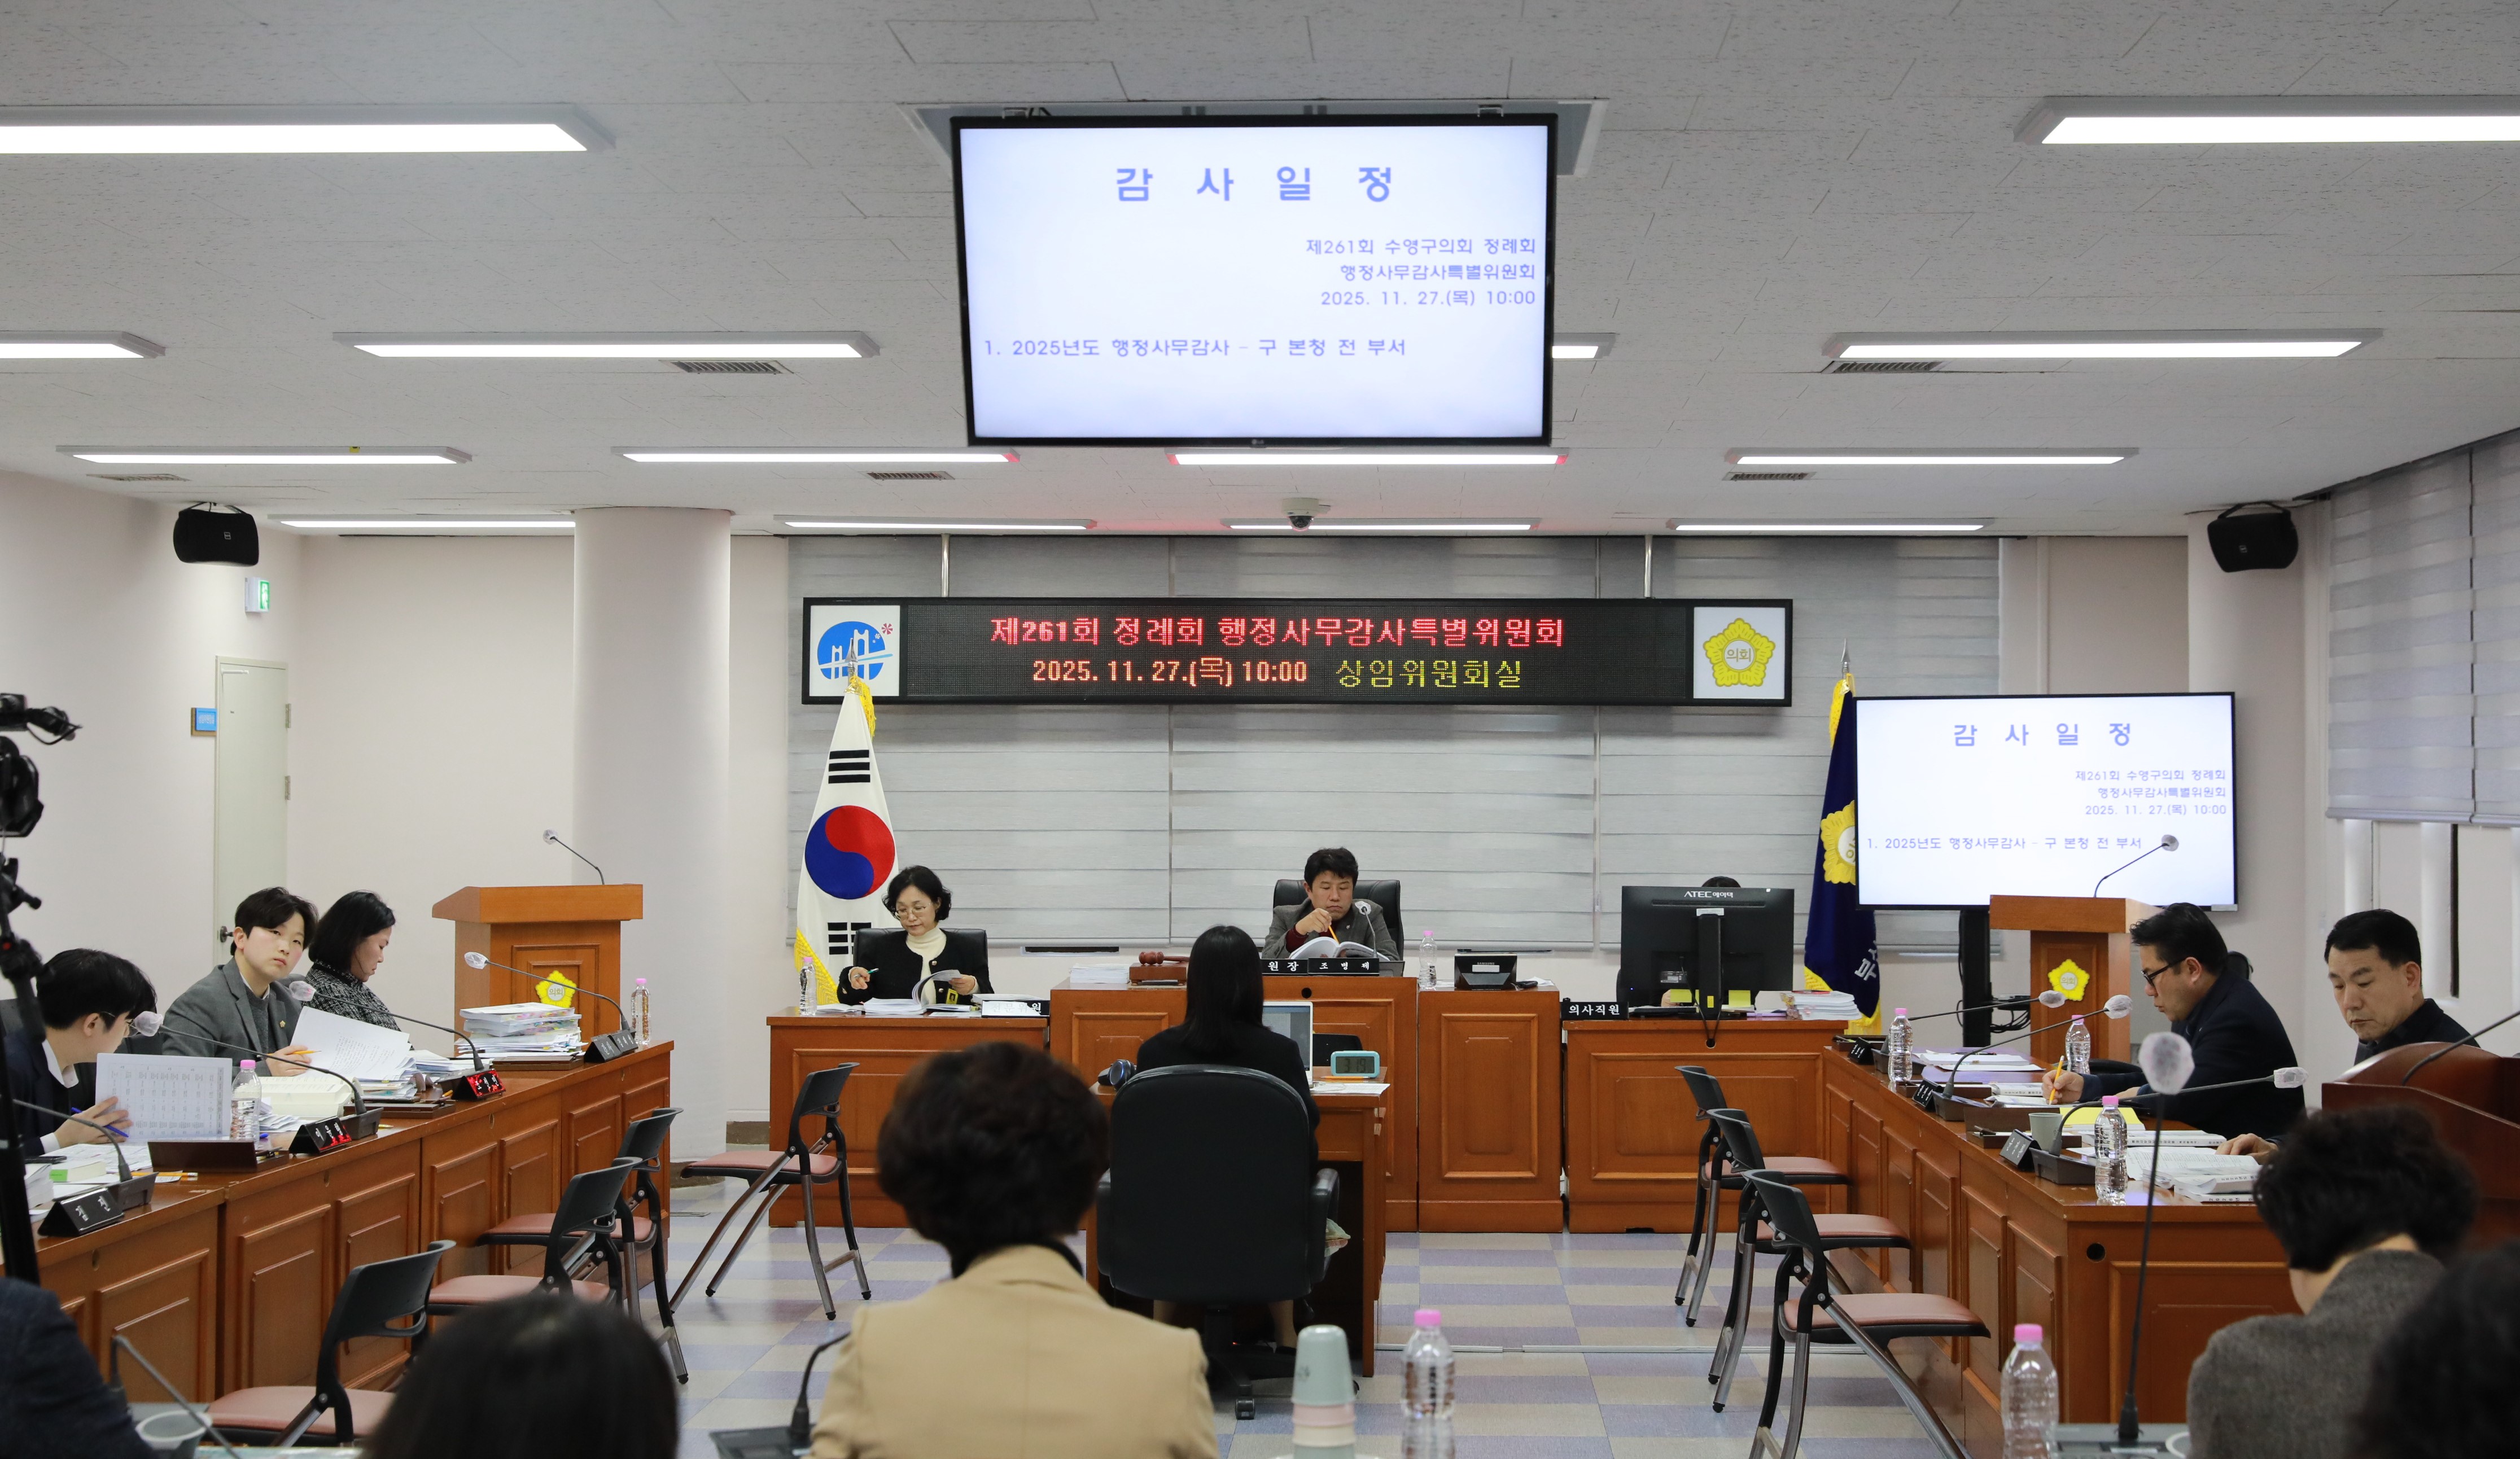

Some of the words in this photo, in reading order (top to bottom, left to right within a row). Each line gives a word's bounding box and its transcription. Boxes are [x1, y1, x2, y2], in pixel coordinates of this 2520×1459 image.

[1306, 238, 1374, 256] 제261회
[1384, 237, 1473, 256] 수영구의회
[1483, 237, 1536, 255] 정례회
[1340, 262, 1535, 282] 행정사무감사특별위원회
[1320, 290, 1370, 306] 2025.
[1381, 290, 1407, 306] 11.
[1417, 290, 1476, 307] 27.(목)
[1486, 290, 1536, 305] 10:00
[985, 340, 1001, 357] 1.
[1011, 339, 1101, 357] 2025년도
[1110, 338, 1230, 358] 행정사무감사
[1258, 339, 1278, 357] 구
[1288, 338, 1326, 357] 본청
[1338, 338, 1357, 357] 전
[1367, 339, 1406, 357] 부서
[990, 616, 1100, 646] 제261회
[1113, 616, 1204, 646] 정례회
[1217, 616, 1564, 647] 행정사무감사특별위원회
[1726, 647, 1752, 663] 의회
[1032, 659, 1099, 682] 2025.
[1107, 660, 1143, 682] 11.
[1152, 656, 1233, 687] 27.(목)
[1242, 660, 1308, 682] 10:00
[1335, 659, 1522, 689] 상임위원회실
[2075, 769, 2120, 782] 제261회
[2126, 769, 2185, 782] 수영구의회
[2191, 769, 2226, 782] 정례회
[2097, 786, 2226, 800] 행정사무감사특별위원회
[2085, 805, 2118, 816] 2025.
[2125, 804, 2142, 815] 11.
[2148, 804, 2188, 816] 27.(목)
[2194, 804, 2227, 815] 10:00
[1866, 837, 1878, 850] 1.
[1884, 837, 1943, 850] 2025년도
[1948, 836, 2027, 851] 행정사무감사
[2044, 836, 2058, 850] 구
[2063, 836, 2090, 851] 본청
[2096, 836, 2110, 850] 전
[2115, 836, 2142, 850] 부서
[2060, 976, 2076, 986] 의회
[549, 988, 563, 997] 의회
[1568, 1004, 1620, 1016] 의사직원
